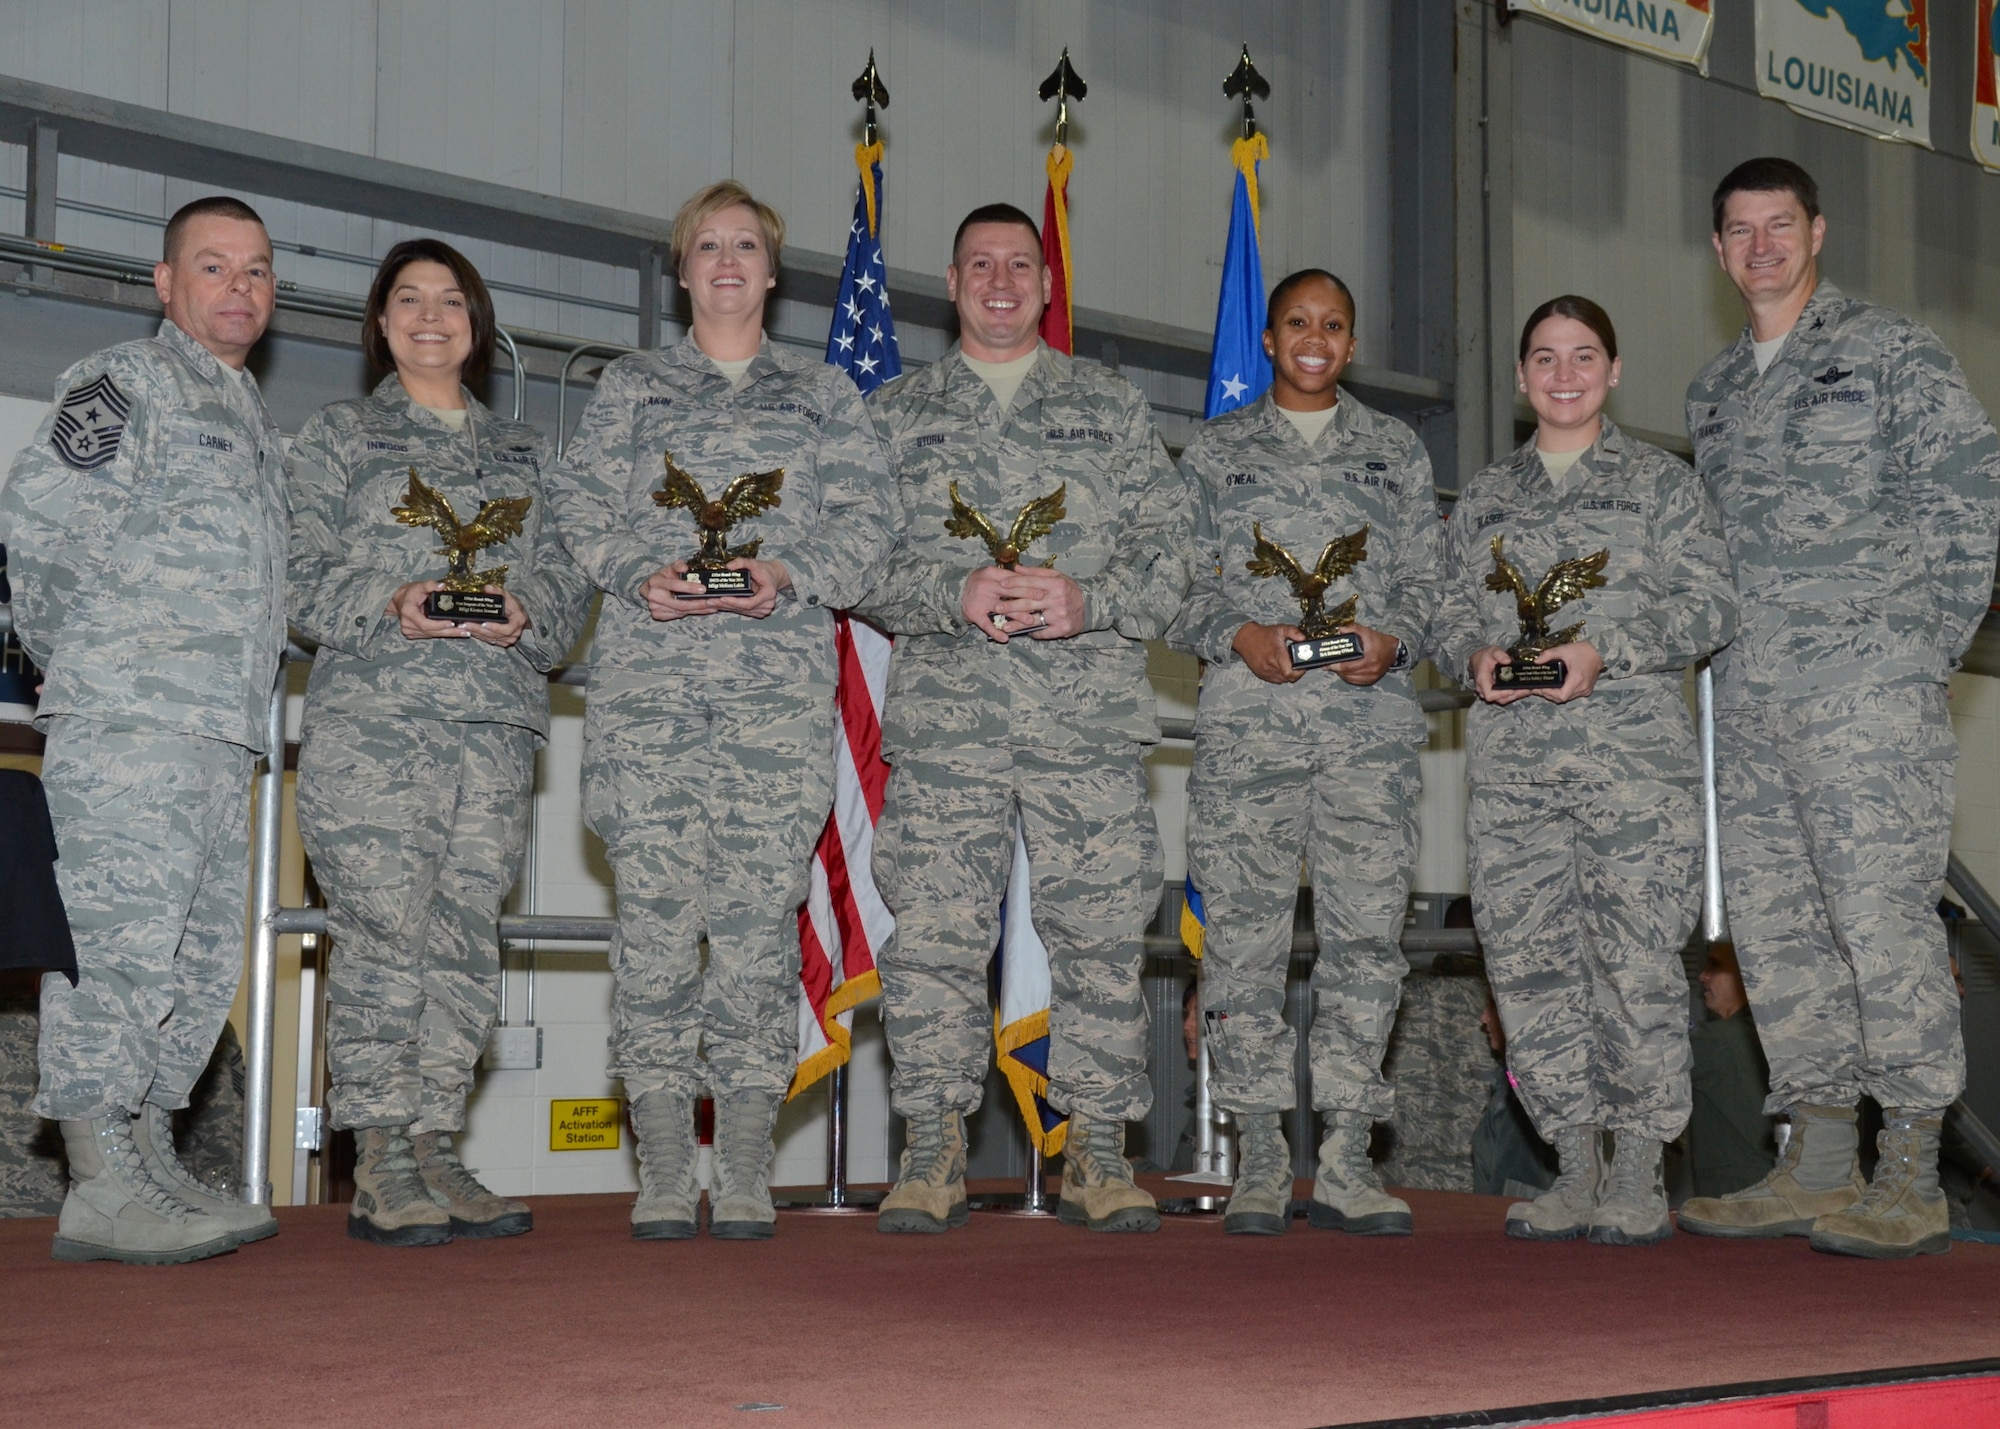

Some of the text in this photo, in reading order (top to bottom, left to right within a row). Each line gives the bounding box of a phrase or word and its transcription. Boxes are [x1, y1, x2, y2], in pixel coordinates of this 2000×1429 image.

[1768, 50, 1915, 128] LOUISIANA
[1811, 393, 1828, 406] AIR
[1830, 390, 1866, 403] FORCE
[780, 402, 796, 413] AIR
[798, 404, 823, 425] FORCE
[199, 433, 233, 453] CARNEY
[916, 433, 945, 447] STORM
[1050, 428, 1114, 444] U.S. AIR FORCE
[367, 440, 408, 452] INWOOD
[1226, 473, 1258, 487] O'NEAL
[1363, 475, 1380, 487] AIR
[1600, 500, 1615, 510] AIR
[1616, 500, 1642, 513] FORCE
[572, 1106, 600, 1117] AFFF
[559, 1119, 612, 1131] Activation
[566, 1132, 605, 1144] Station
